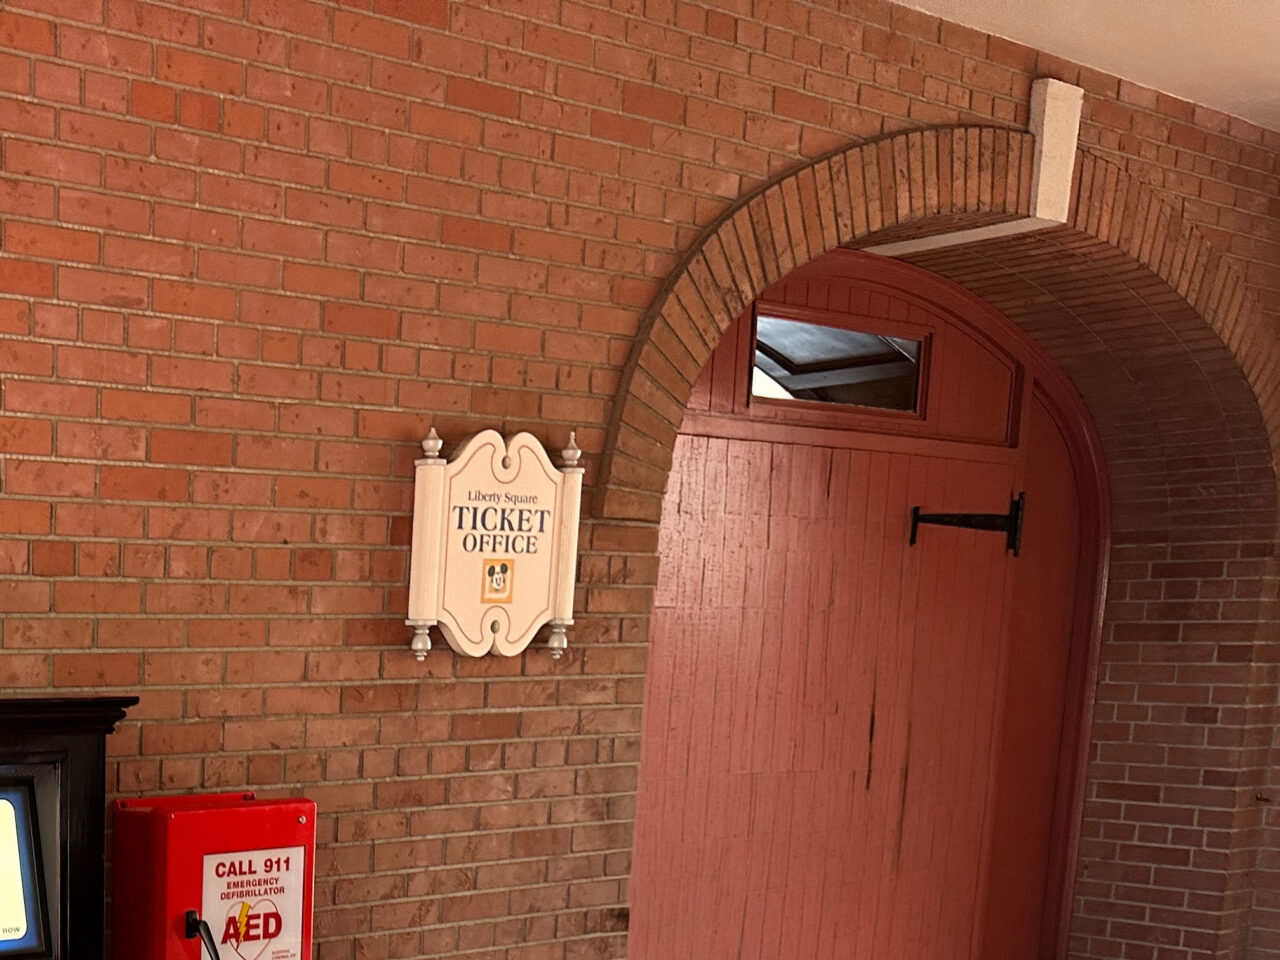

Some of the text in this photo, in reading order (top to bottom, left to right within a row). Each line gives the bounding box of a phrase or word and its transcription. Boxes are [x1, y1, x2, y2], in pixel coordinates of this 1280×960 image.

[468, 490, 538, 506] Liberty Square
[452, 506, 551, 533] TICKET
[462, 532, 538, 554] OFFICE
[215, 856, 290, 878] CALL 911
[226, 876, 280, 890] EMERGENCY
[220, 886, 285, 900] DEFIBRILLATOR
[2, 926, 20, 934] now
[221, 911, 282, 945] AED
